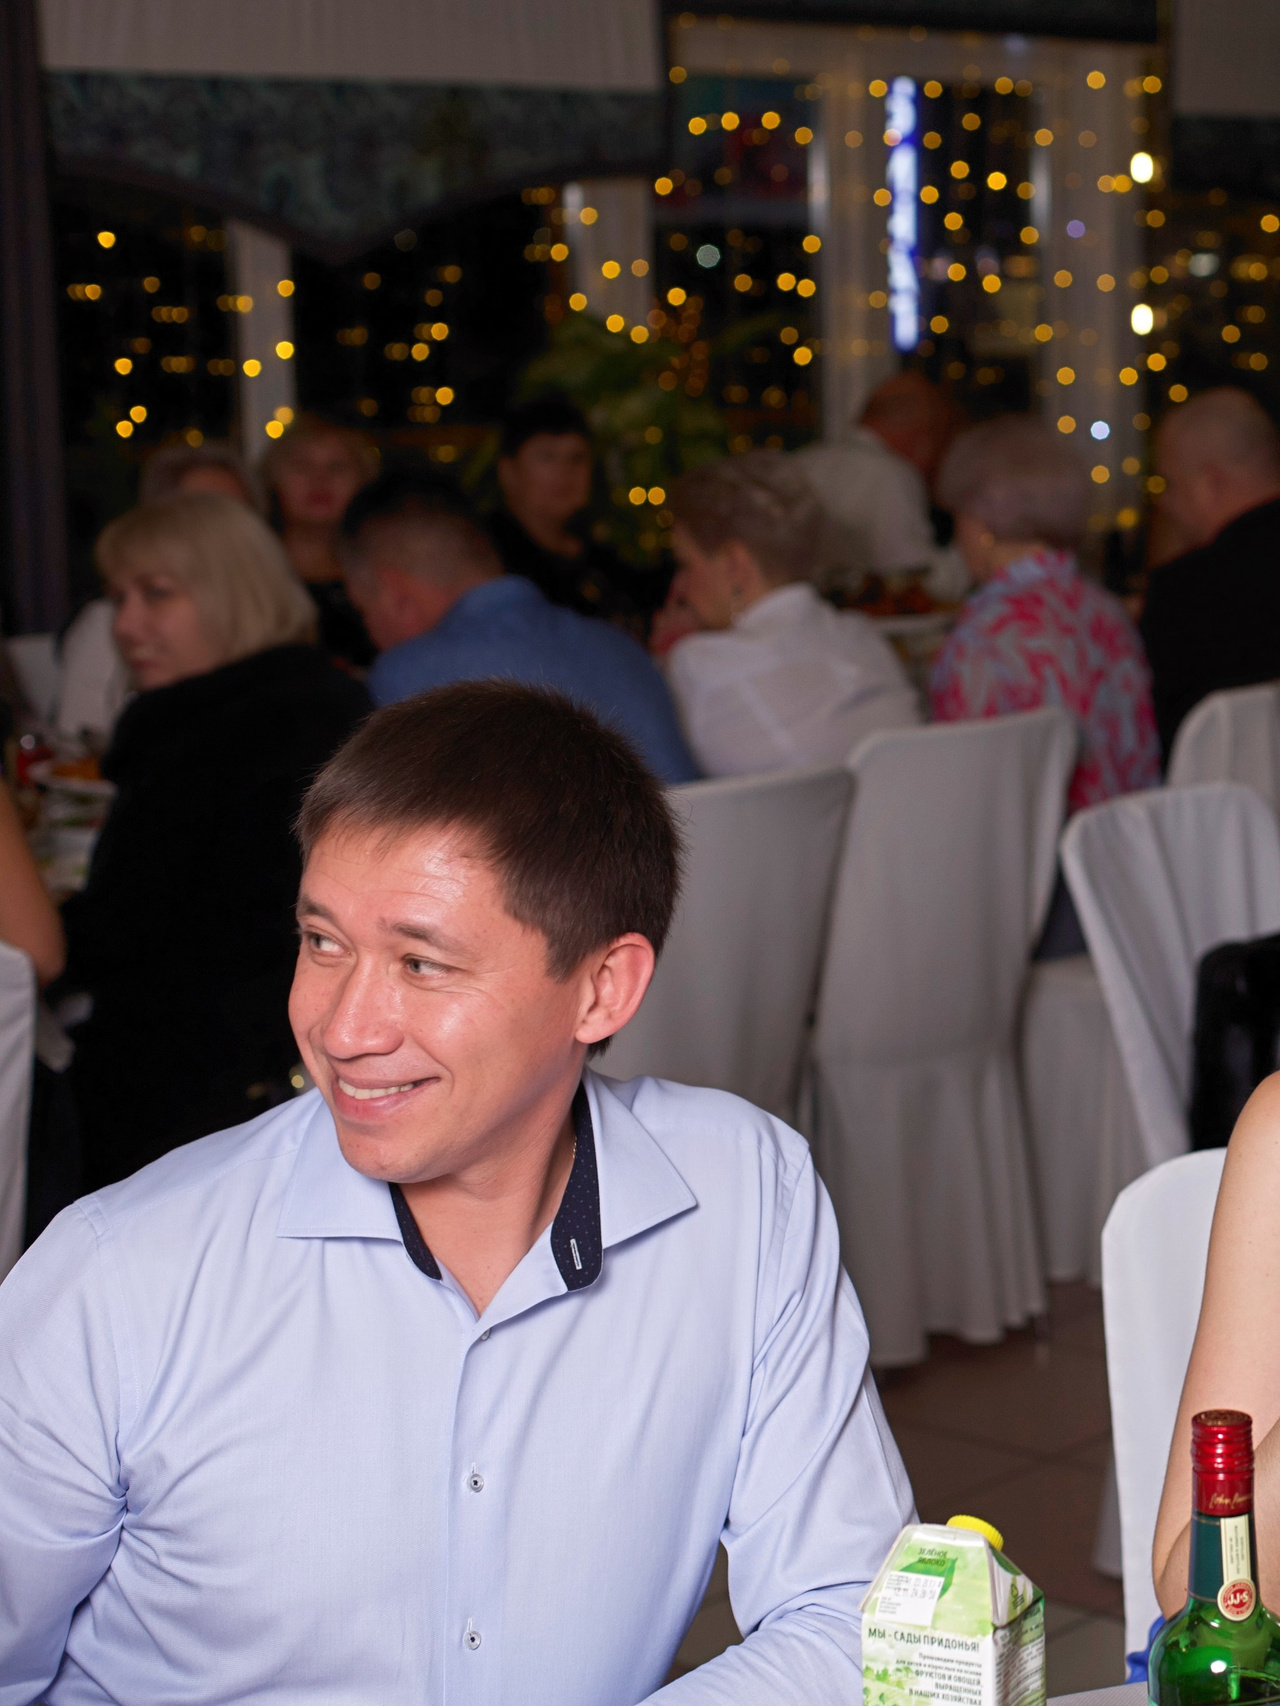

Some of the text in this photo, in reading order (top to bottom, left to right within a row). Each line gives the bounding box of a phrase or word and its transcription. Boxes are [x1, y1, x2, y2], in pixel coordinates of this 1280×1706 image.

[918, 1547, 948, 1559] ЗЕЛЁНОЕ
[917, 1557, 946, 1567] ЯБЛОКО
[868, 1627, 886, 1639] МЫ
[893, 1630, 921, 1645] САДЫ
[923, 1634, 980, 1653] ПРИДОНЬЯ!
[914, 1669, 946, 1681] ФРУКТОВ
[934, 1682, 982, 1697] ВЫРАЩЕННЫХ
[908, 1688, 982, 1706] В НАШИХ ХОЗЯЙСТВАХ
